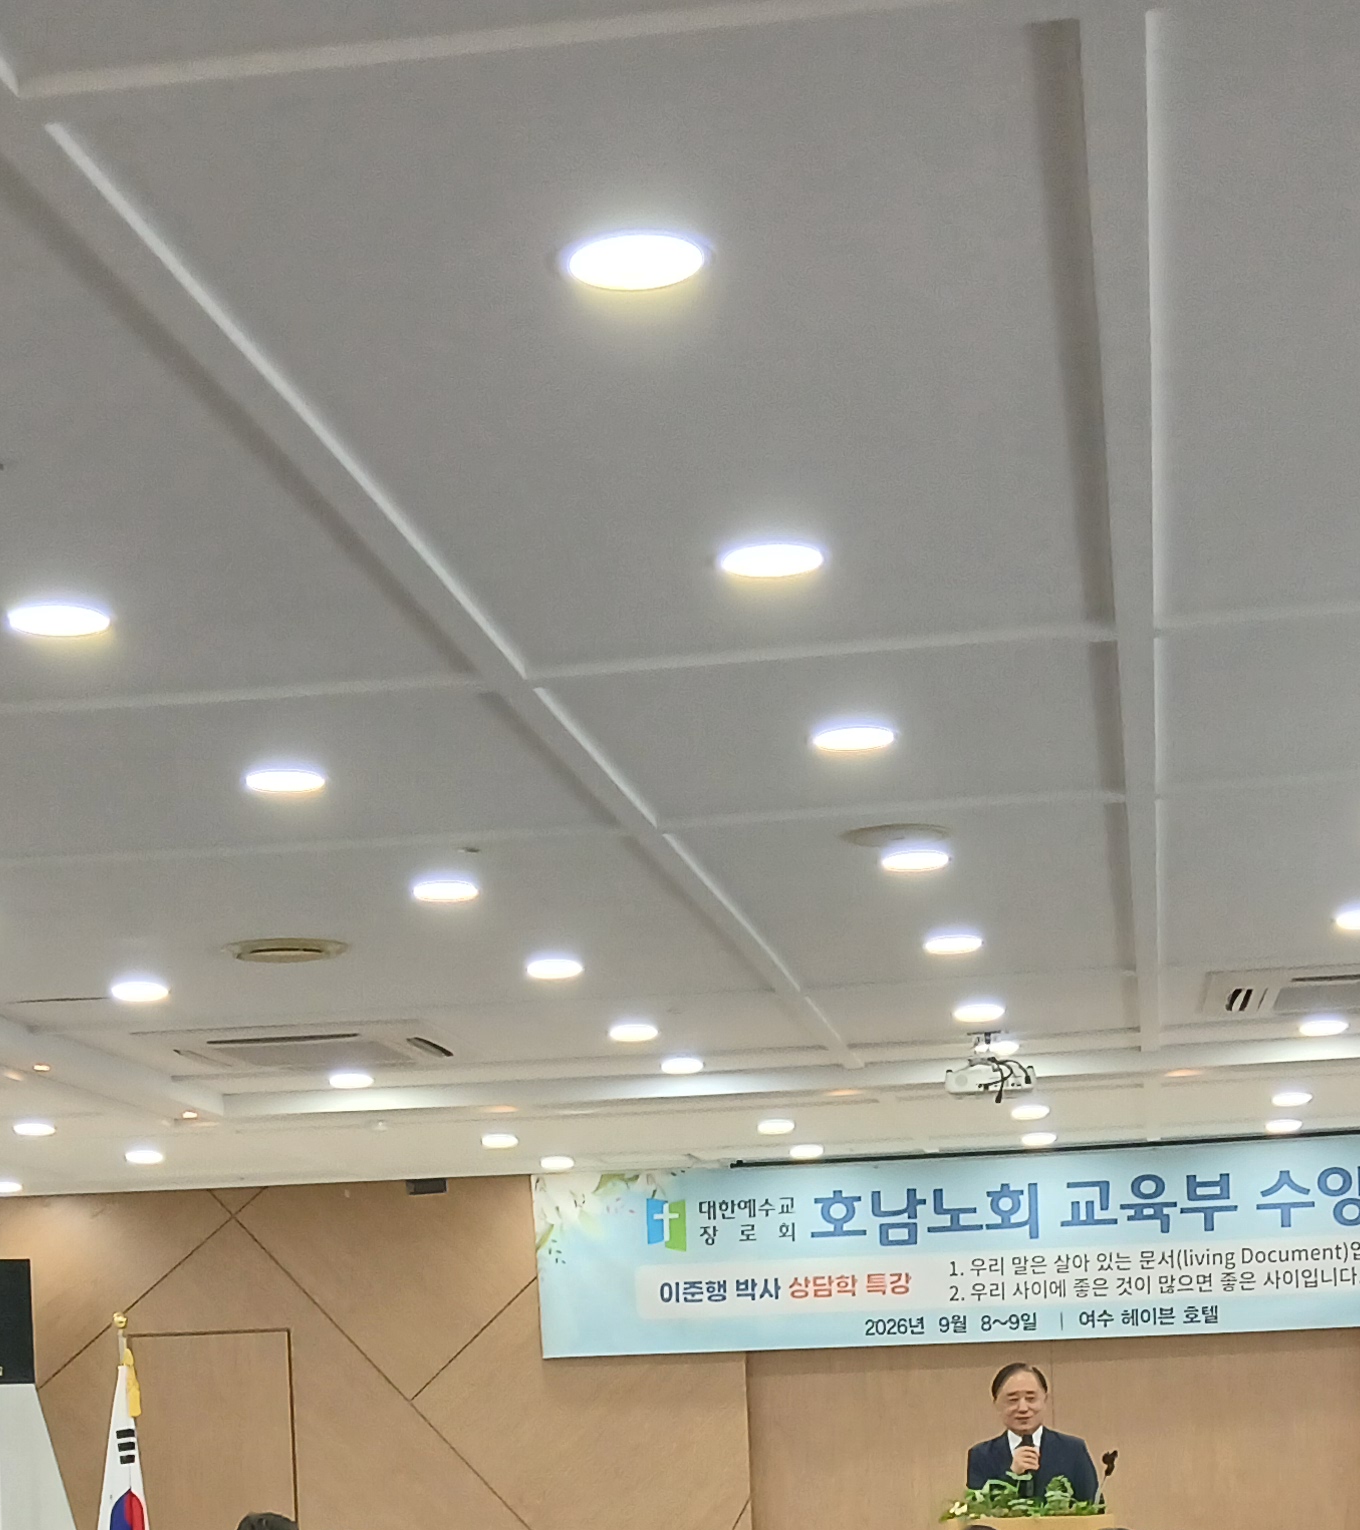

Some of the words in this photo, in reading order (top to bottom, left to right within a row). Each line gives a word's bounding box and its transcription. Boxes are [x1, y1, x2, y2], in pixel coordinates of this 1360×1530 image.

[698, 1196, 796, 1221] 대한예수교
[810, 1181, 1040, 1247] 호남노회
[1060, 1172, 1239, 1234] 교육부
[949, 1259, 965, 1277] 1.
[970, 1255, 1005, 1277] 우리
[1011, 1254, 1048, 1276] 말은
[1053, 1252, 1090, 1274] 살아
[1096, 1250, 1132, 1272] 있는
[1139, 1247, 1236, 1271] 문서(living
[659, 1278, 728, 1304] 이준행
[735, 1276, 781, 1301] 박사
[788, 1272, 858, 1299] 상담학
[865, 1271, 912, 1296] 특강
[949, 1284, 965, 1301] 2.
[970, 1280, 1006, 1301] 우리
[1012, 1278, 1067, 1300] 사이에
[1073, 1276, 1109, 1298] 좋은
[1116, 1274, 1151, 1296] 것이
[1158, 1271, 1213, 1294] 많으면
[1220, 1269, 1256, 1291] 좋은
[864, 1315, 925, 1337] 2026년
[939, 1313, 967, 1334] 9월
[1079, 1308, 1114, 1328] 여수
[1121, 1306, 1176, 1327] 헤이븐
[1182, 1304, 1219, 1325] 호텔
